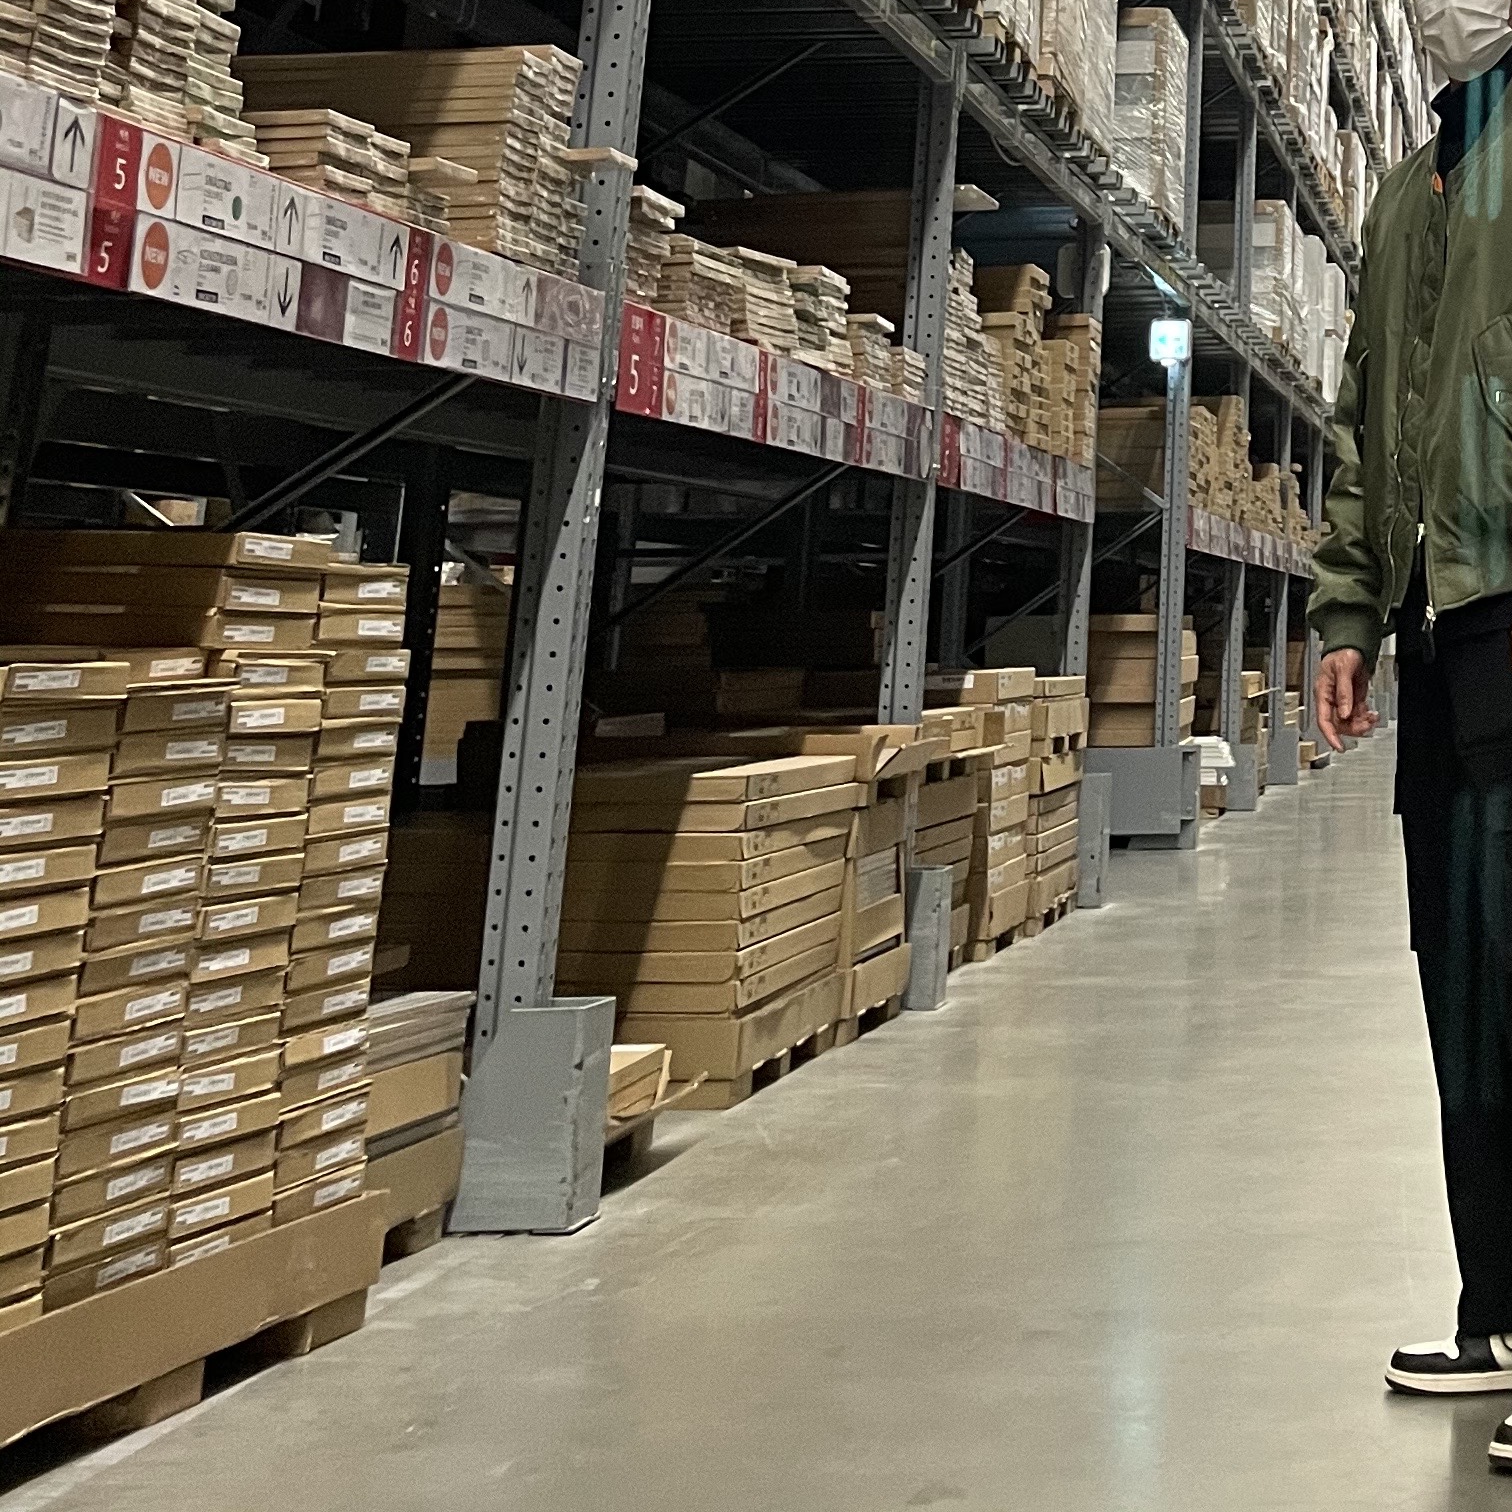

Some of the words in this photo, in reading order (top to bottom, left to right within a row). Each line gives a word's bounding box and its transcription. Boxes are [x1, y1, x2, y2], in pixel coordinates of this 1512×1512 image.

[112, 157, 128, 191] 5
[147, 166, 170, 187] NEW
[96, 240, 114, 274] 5
[144, 244, 167, 266] NEW
[410, 259, 420, 286] 6
[402, 320, 413, 348] 6
[629, 354, 640, 396] 5
